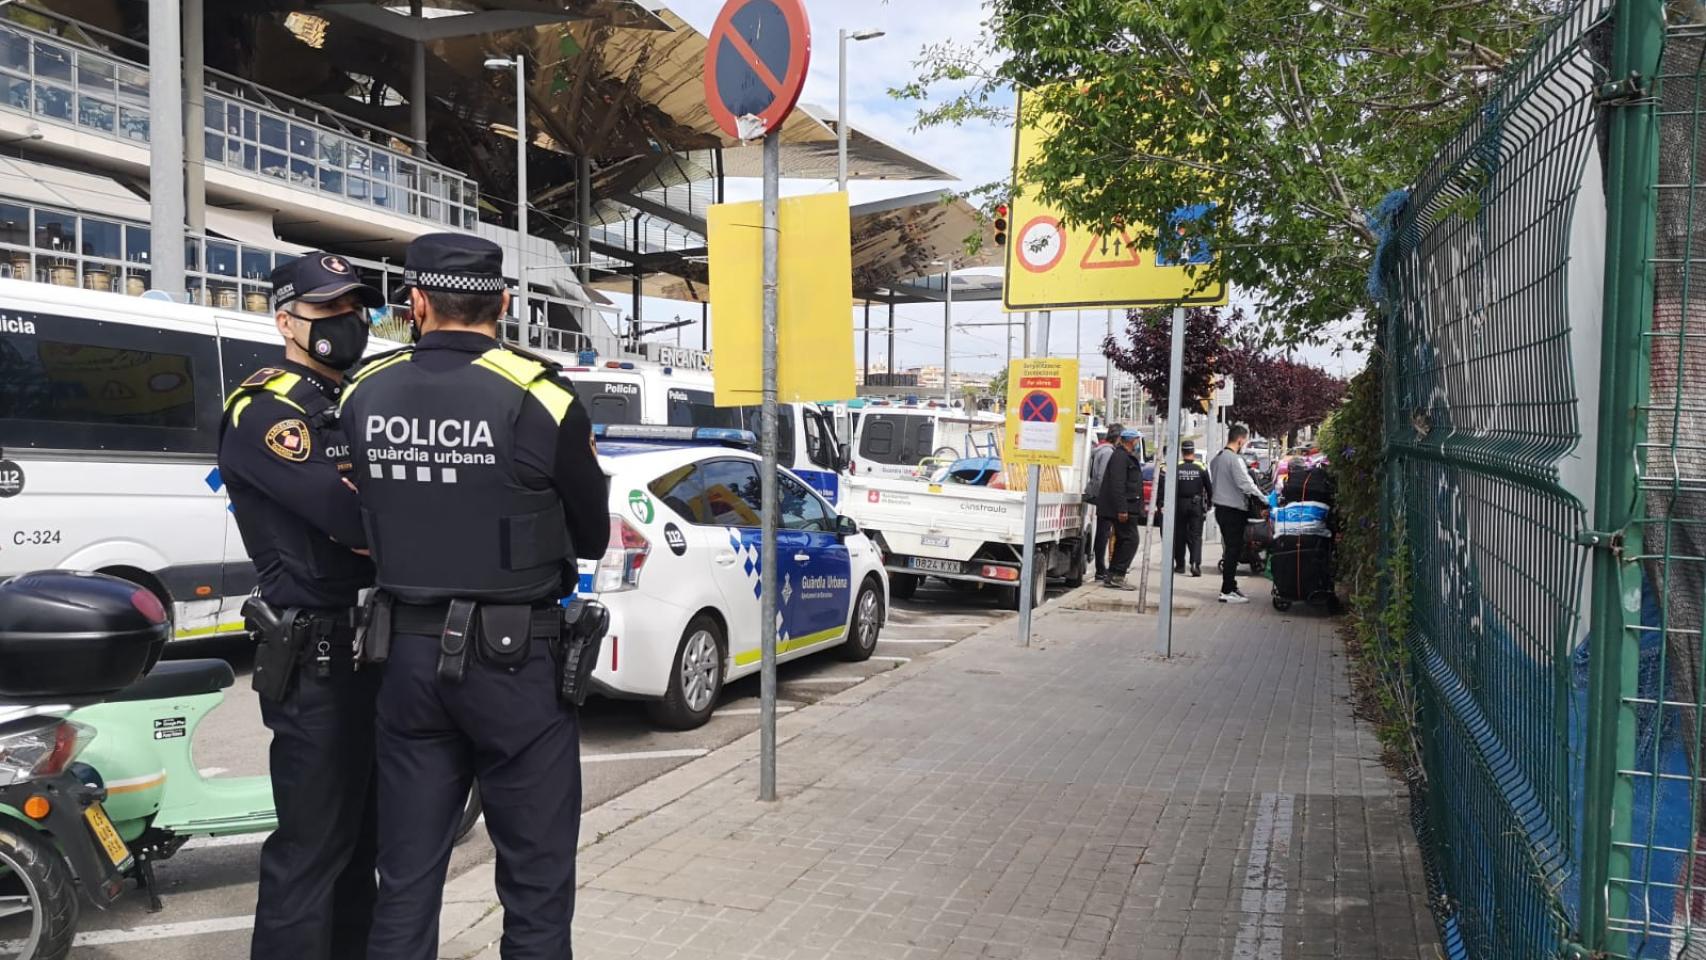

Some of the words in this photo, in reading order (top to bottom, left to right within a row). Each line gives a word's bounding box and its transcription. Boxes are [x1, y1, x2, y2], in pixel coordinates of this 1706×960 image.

[366, 415, 495, 447] POLICIA
[367, 446, 429, 461] guàrdia
[434, 450, 496, 464] urbana
[13, 530, 61, 545] C-324
[666, 530, 683, 543] 112
[915, 557, 938, 570] 0824
